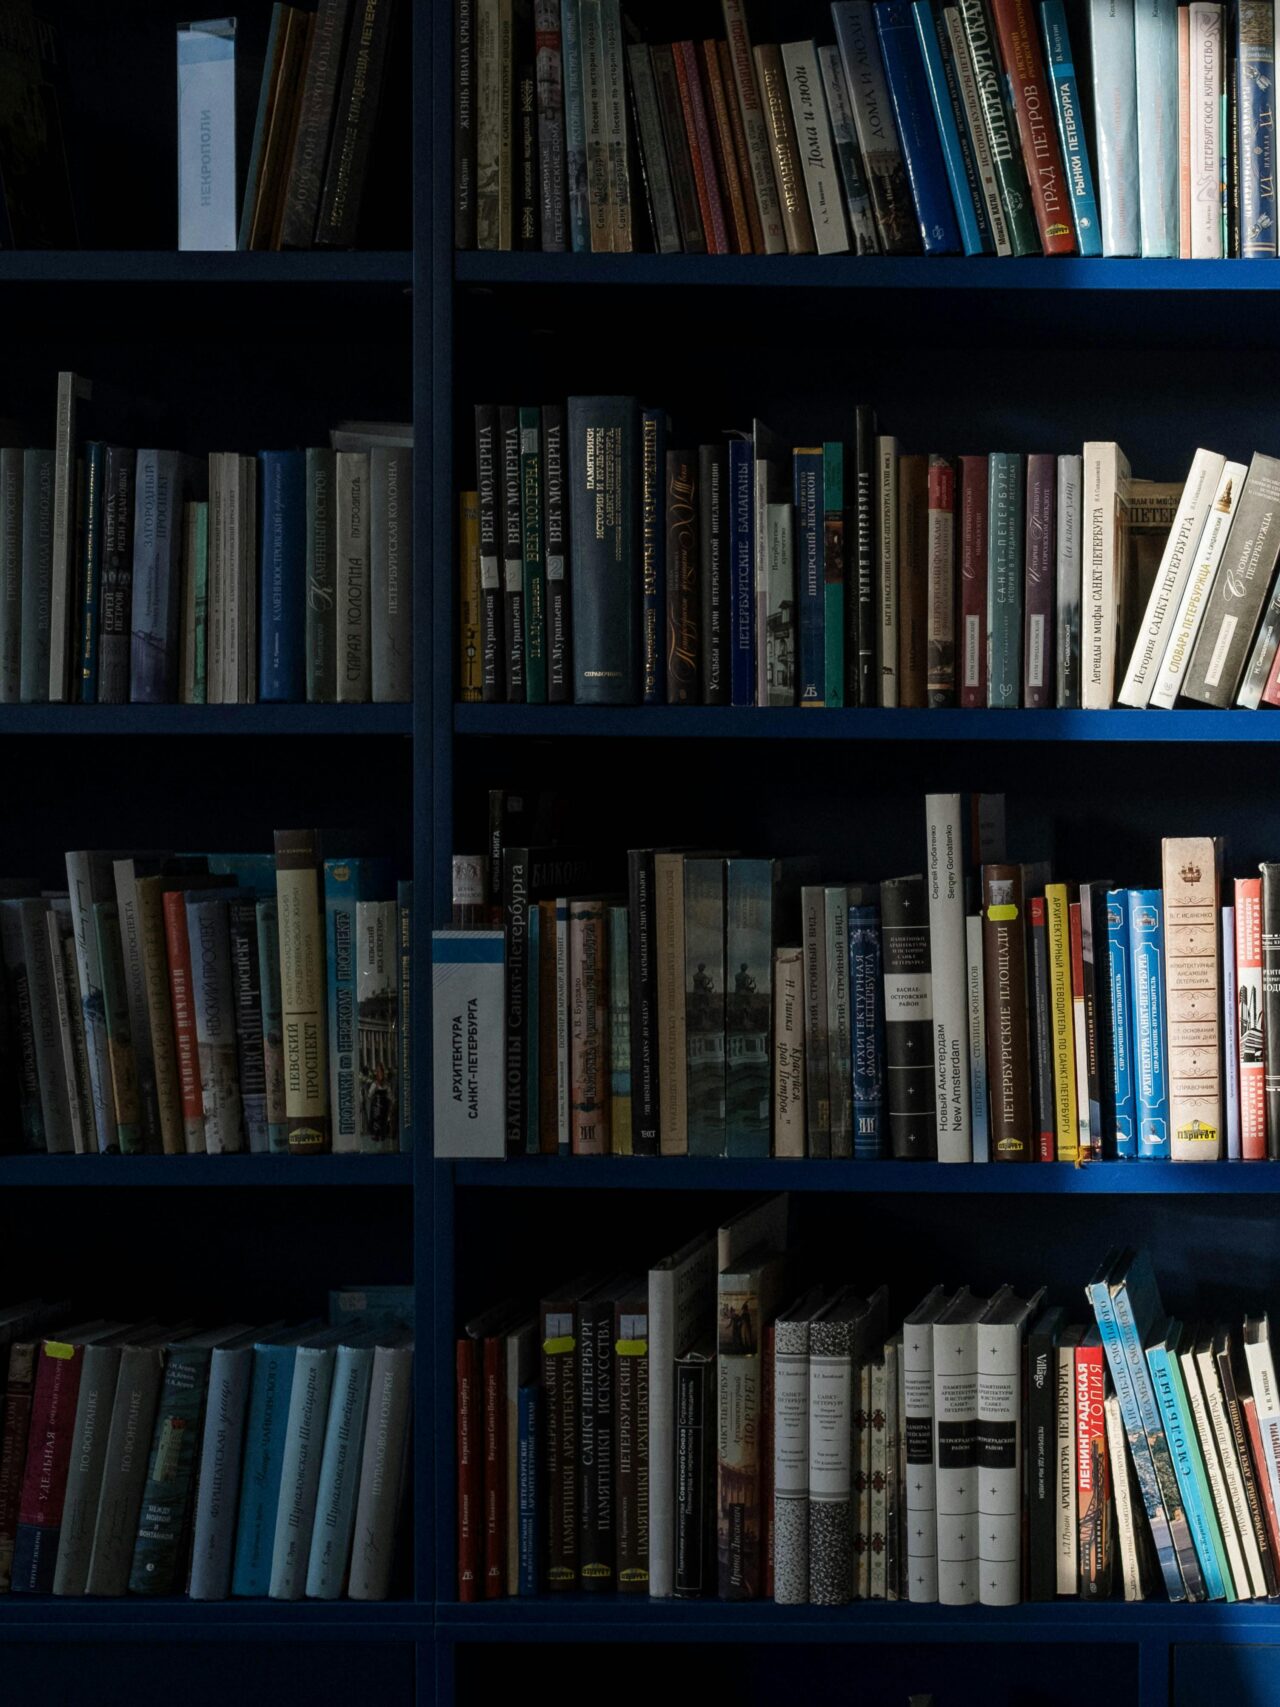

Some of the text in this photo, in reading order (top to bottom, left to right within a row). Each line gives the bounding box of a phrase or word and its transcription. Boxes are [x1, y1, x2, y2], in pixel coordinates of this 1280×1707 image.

[791, 65, 825, 168] Дома и люди
[849, 15, 885, 138] ДОМА И ЛЮДИ
[950, 17, 1007, 246] Моисей КАГАН ИСТОРИЯ КУЛЬТУРЫ ПЕТЕРБУРГА
[1204, 40, 1214, 171] ПЕТЕРБУРГСКОЕ КУПЕЧЕСТВО
[200, 109, 211, 207] НЕКРОПОЛИ
[1023, 84, 1060, 212] ГРАД ПЕТРОВ
[1060, 83, 1086, 196] РЫНКИ ПЕТЕРБУРГА
[388, 460, 399, 614] ПЕТЕРБУРГСКАЯ КОЛОМНА
[480, 426, 495, 543] ВЕК МОДЕРНА
[547, 424, 563, 543] ВЕК МОДЕРНА
[346, 477, 363, 681] СТАРАЯ КОЛОМНА ПУТЕВОДИТЕЛЬ
[737, 462, 750, 649] ПЕТЕРБУРГСКИЕ БАЛАГАНЫ
[1092, 507, 1104, 601] САНКТ-ПЕТЕРБУРГА
[1132, 516, 1196, 684] История САНКТ-ПЕТЕРБУРГА
[1091, 645, 1104, 685] Легенды
[1092, 605, 1104, 633] мифы
[1168, 563, 1212, 674] СЛОВАРЬ ПЕТЕРБУРЖЦА
[930, 824, 939, 899] Сергей Горбатенко
[945, 824, 955, 899] Sergey Gorbatenko
[288, 1023, 302, 1092] НЕВСКИЙ
[452, 1016, 463, 1102] АРХИТЕКТУРА
[467, 998, 479, 1119] САНКТ-ПЕТЕРБУРГА
[507, 863, 524, 1140] БАЛКОНЫ Санкт-Петербурга
[998, 927, 1015, 1122] ПЕТЕРБУРГСКИЕ ПЛОЩАДИ
[1052, 897, 1071, 1135] АРХИТЕКТУРНЫЙ ПУТЕВОДИТЕЛЬ ПО САНКТ-ПЕТЕРБУРГУ
[304, 1022, 321, 1099] ПРОСПЕКТ
[936, 1024, 948, 1132] Новый Амстердам
[950, 1039, 961, 1132] New Amsterdam
[79, 1390, 98, 1472] ПО ФОНТАНКЕ
[582, 1318, 594, 1466] САНКТ-ПЕТЕРБУРГ
[598, 1319, 611, 1530] ПАМЯТНИКИ ИСКУССТВА
[620, 1357, 631, 1473] ПЕТЕРБУРГСКИЕ
[1057, 1363, 1070, 1511] АРХИТЕКТУРА ПЕТЕРБУРГА
[1077, 1363, 1091, 1490] ЛЕНИНГРАДСКАЯ
[1089, 1363, 1103, 1438] УТОПИЯ
[1155, 1366, 1192, 1476] СМОЛЬНЫЙ
[38, 1431, 56, 1500] УДЕЛЬНАЯ
[636, 1357, 648, 1555] ПАМЯТНИКИ АРХИТЕКТУРЫ
